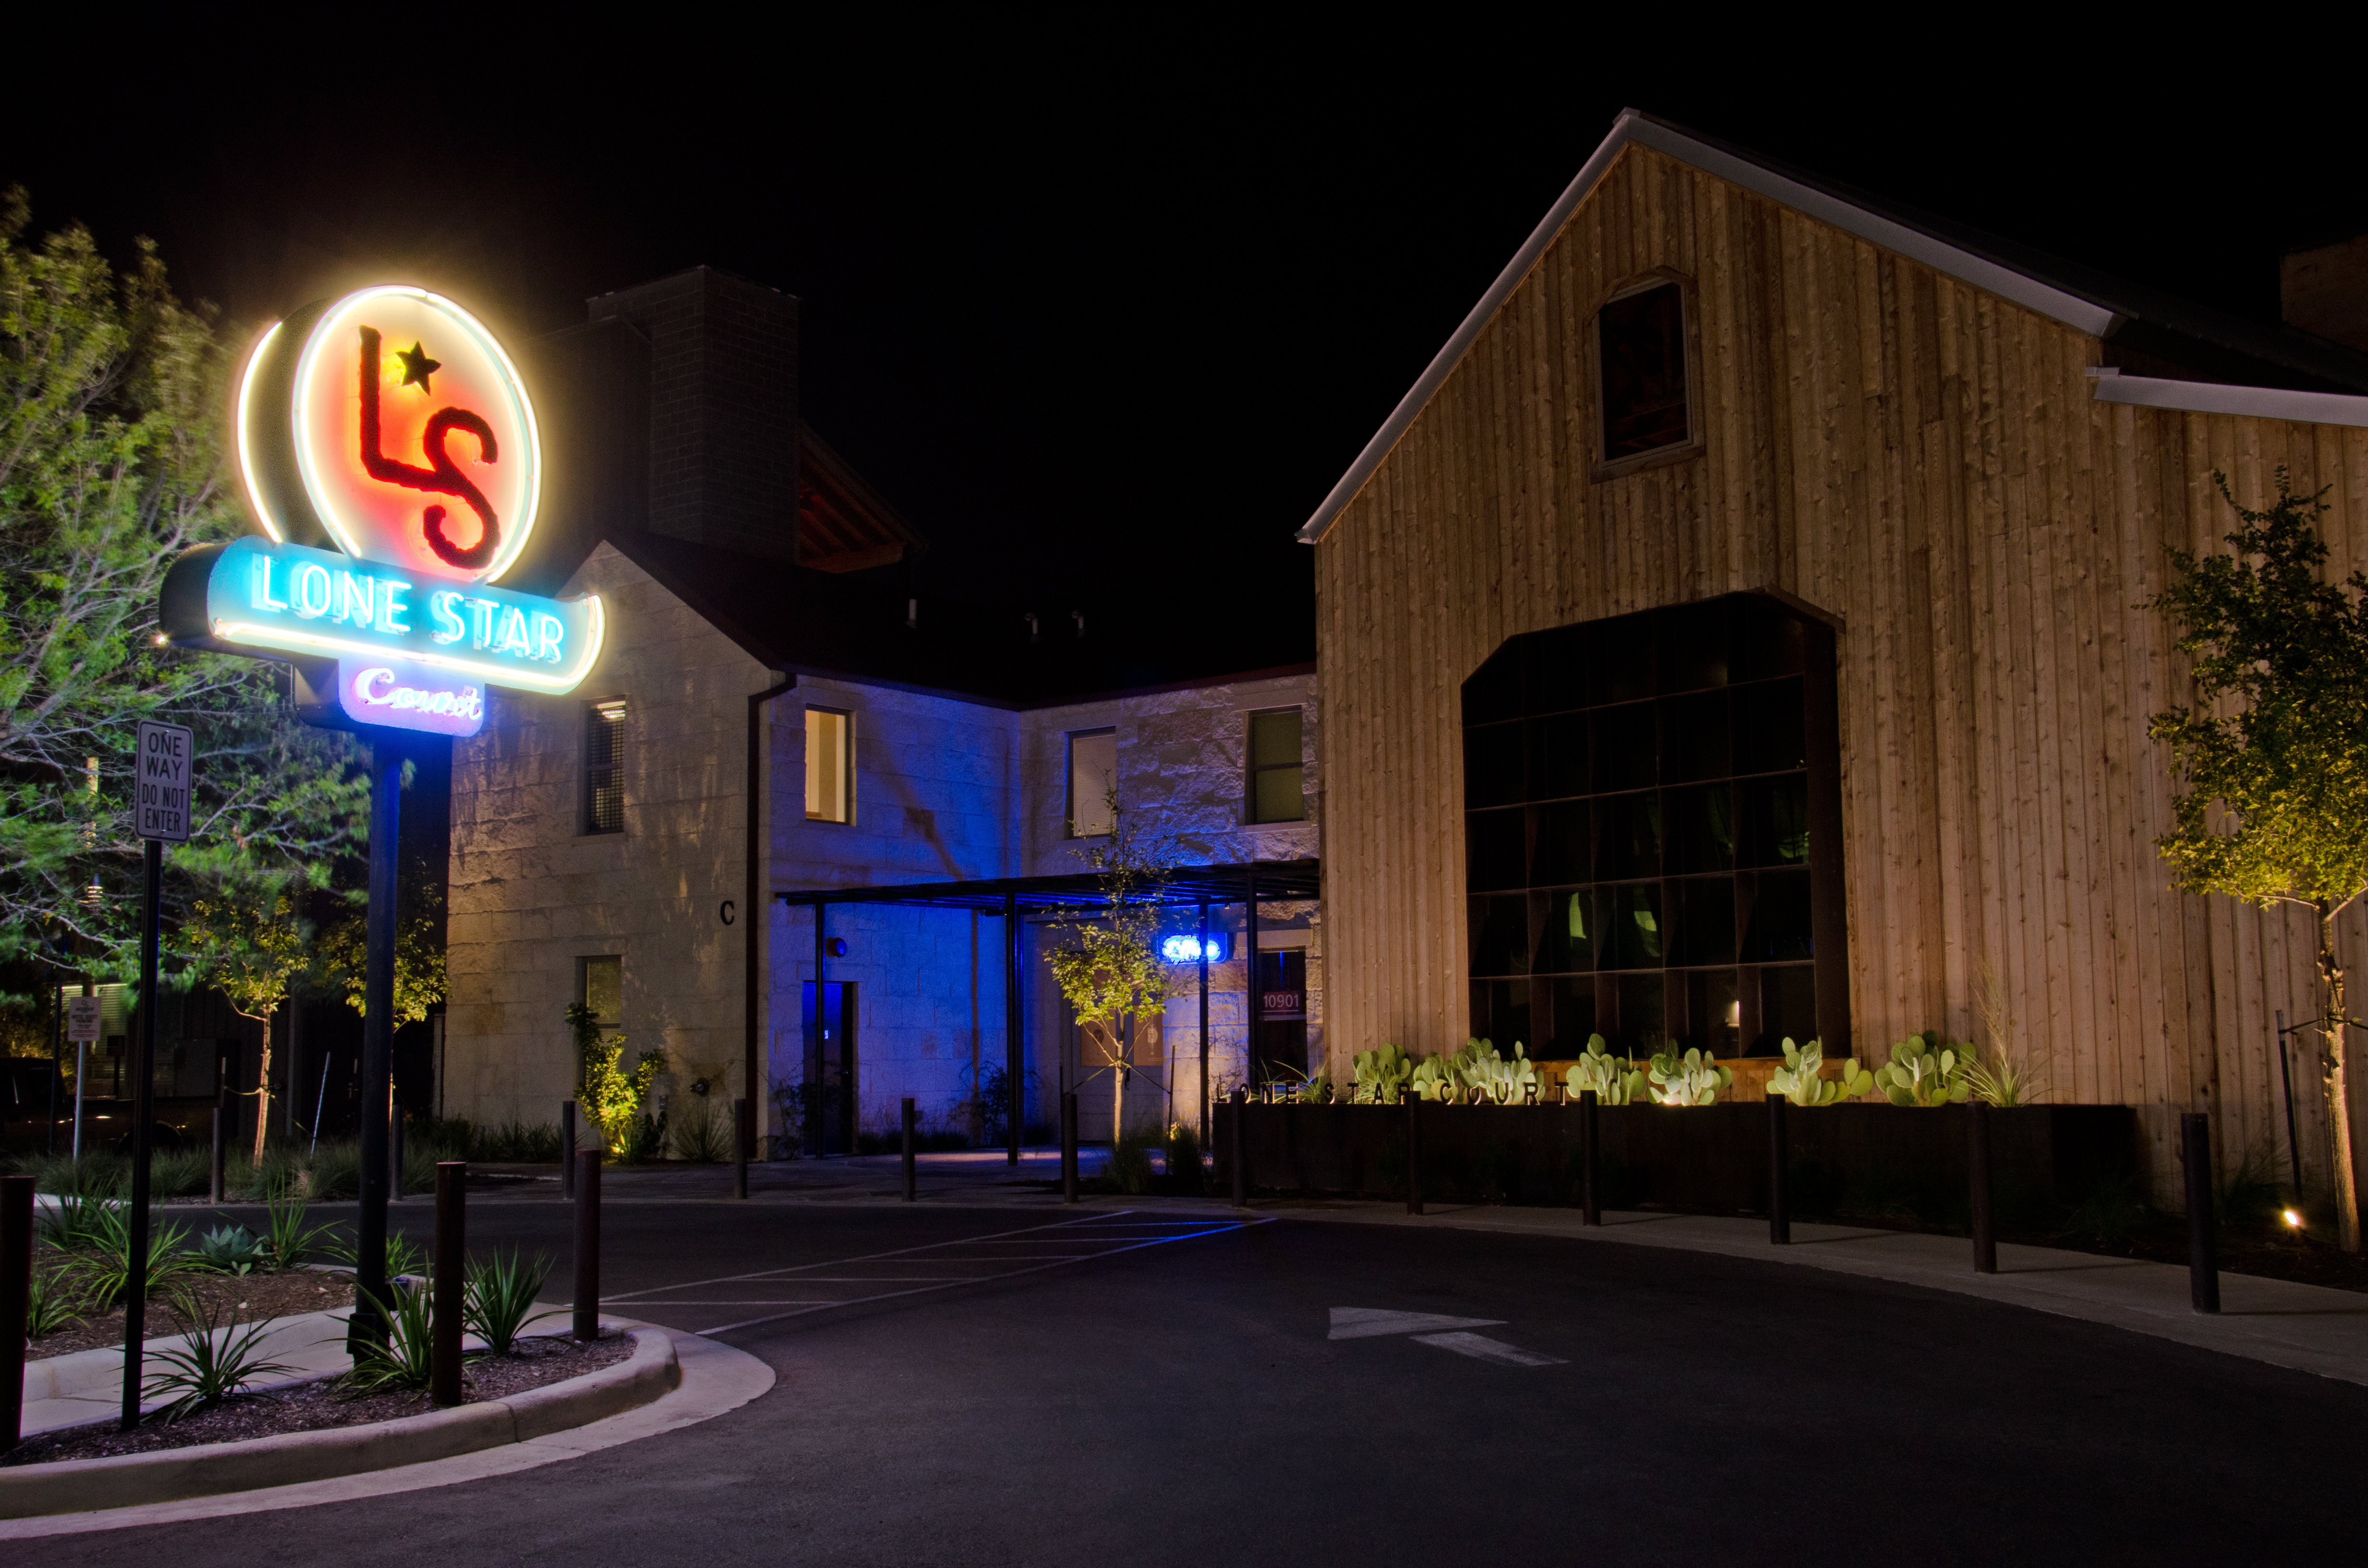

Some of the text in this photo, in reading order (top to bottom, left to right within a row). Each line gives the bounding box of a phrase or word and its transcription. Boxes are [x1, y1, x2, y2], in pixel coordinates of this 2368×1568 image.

[252, 552, 564, 663] LONE STAR
[351, 667, 482, 720] Court
[148, 732, 182, 757] ONE
[146, 755, 183, 781] WAY
[142, 783, 185, 809] DO NOT
[145, 808, 181, 832] ENTER
[720, 900, 735, 926] C
[1263, 994, 1299, 1008] 10901
[1440, 1082, 1569, 1105] COURT
